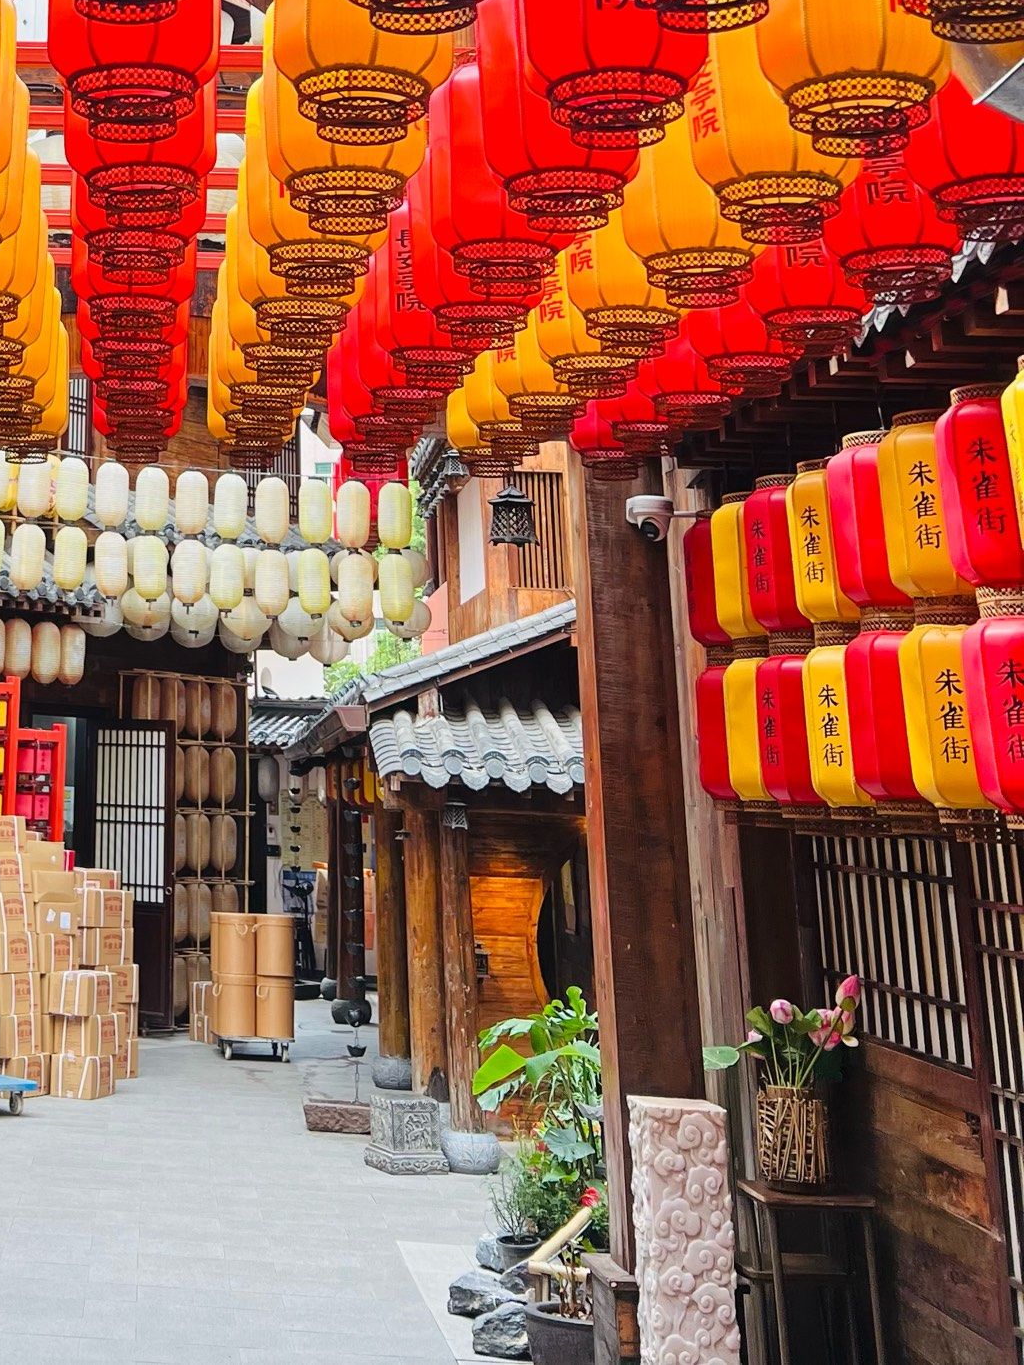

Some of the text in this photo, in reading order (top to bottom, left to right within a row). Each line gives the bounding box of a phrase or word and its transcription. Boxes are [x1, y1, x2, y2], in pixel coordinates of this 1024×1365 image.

[539, 257, 565, 323] 亭院
[907, 461, 942, 549] 朱雀街
[966, 438, 1007, 535] 朱雀街
[752, 520, 770, 594] 朱雀街
[800, 505, 826, 584] 朱雀街
[762, 688, 781, 768] 朱雀街
[817, 684, 844, 768] 朱雀街
[934, 668, 971, 765] 朱雀街
